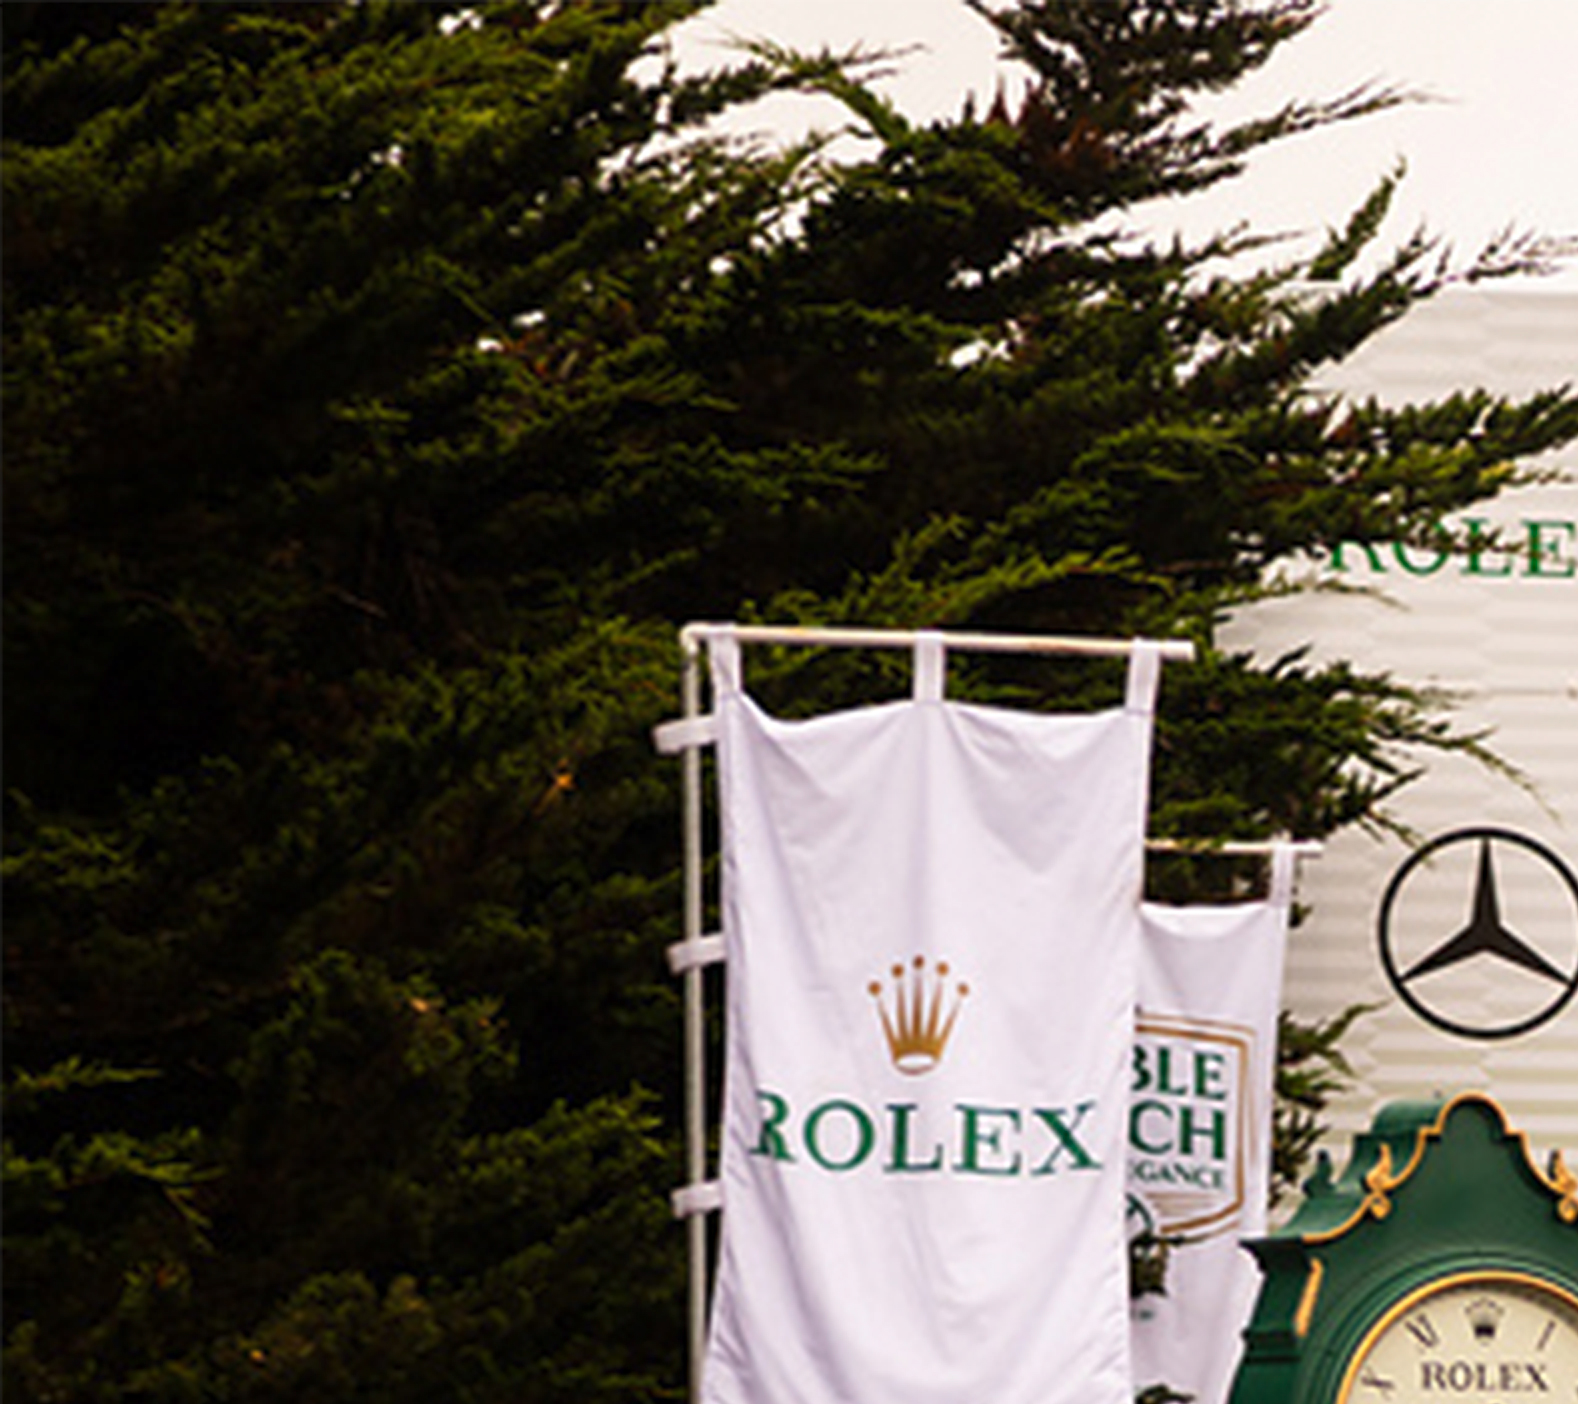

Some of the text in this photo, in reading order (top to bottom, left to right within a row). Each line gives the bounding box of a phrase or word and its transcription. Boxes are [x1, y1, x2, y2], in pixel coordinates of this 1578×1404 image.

[1131, 1045, 1227, 1101] BLE
[750, 1090, 1103, 1177] ROLEX
[1127, 1157, 1226, 1189] GANCE
[1421, 1360, 1550, 1392] ROLEX
